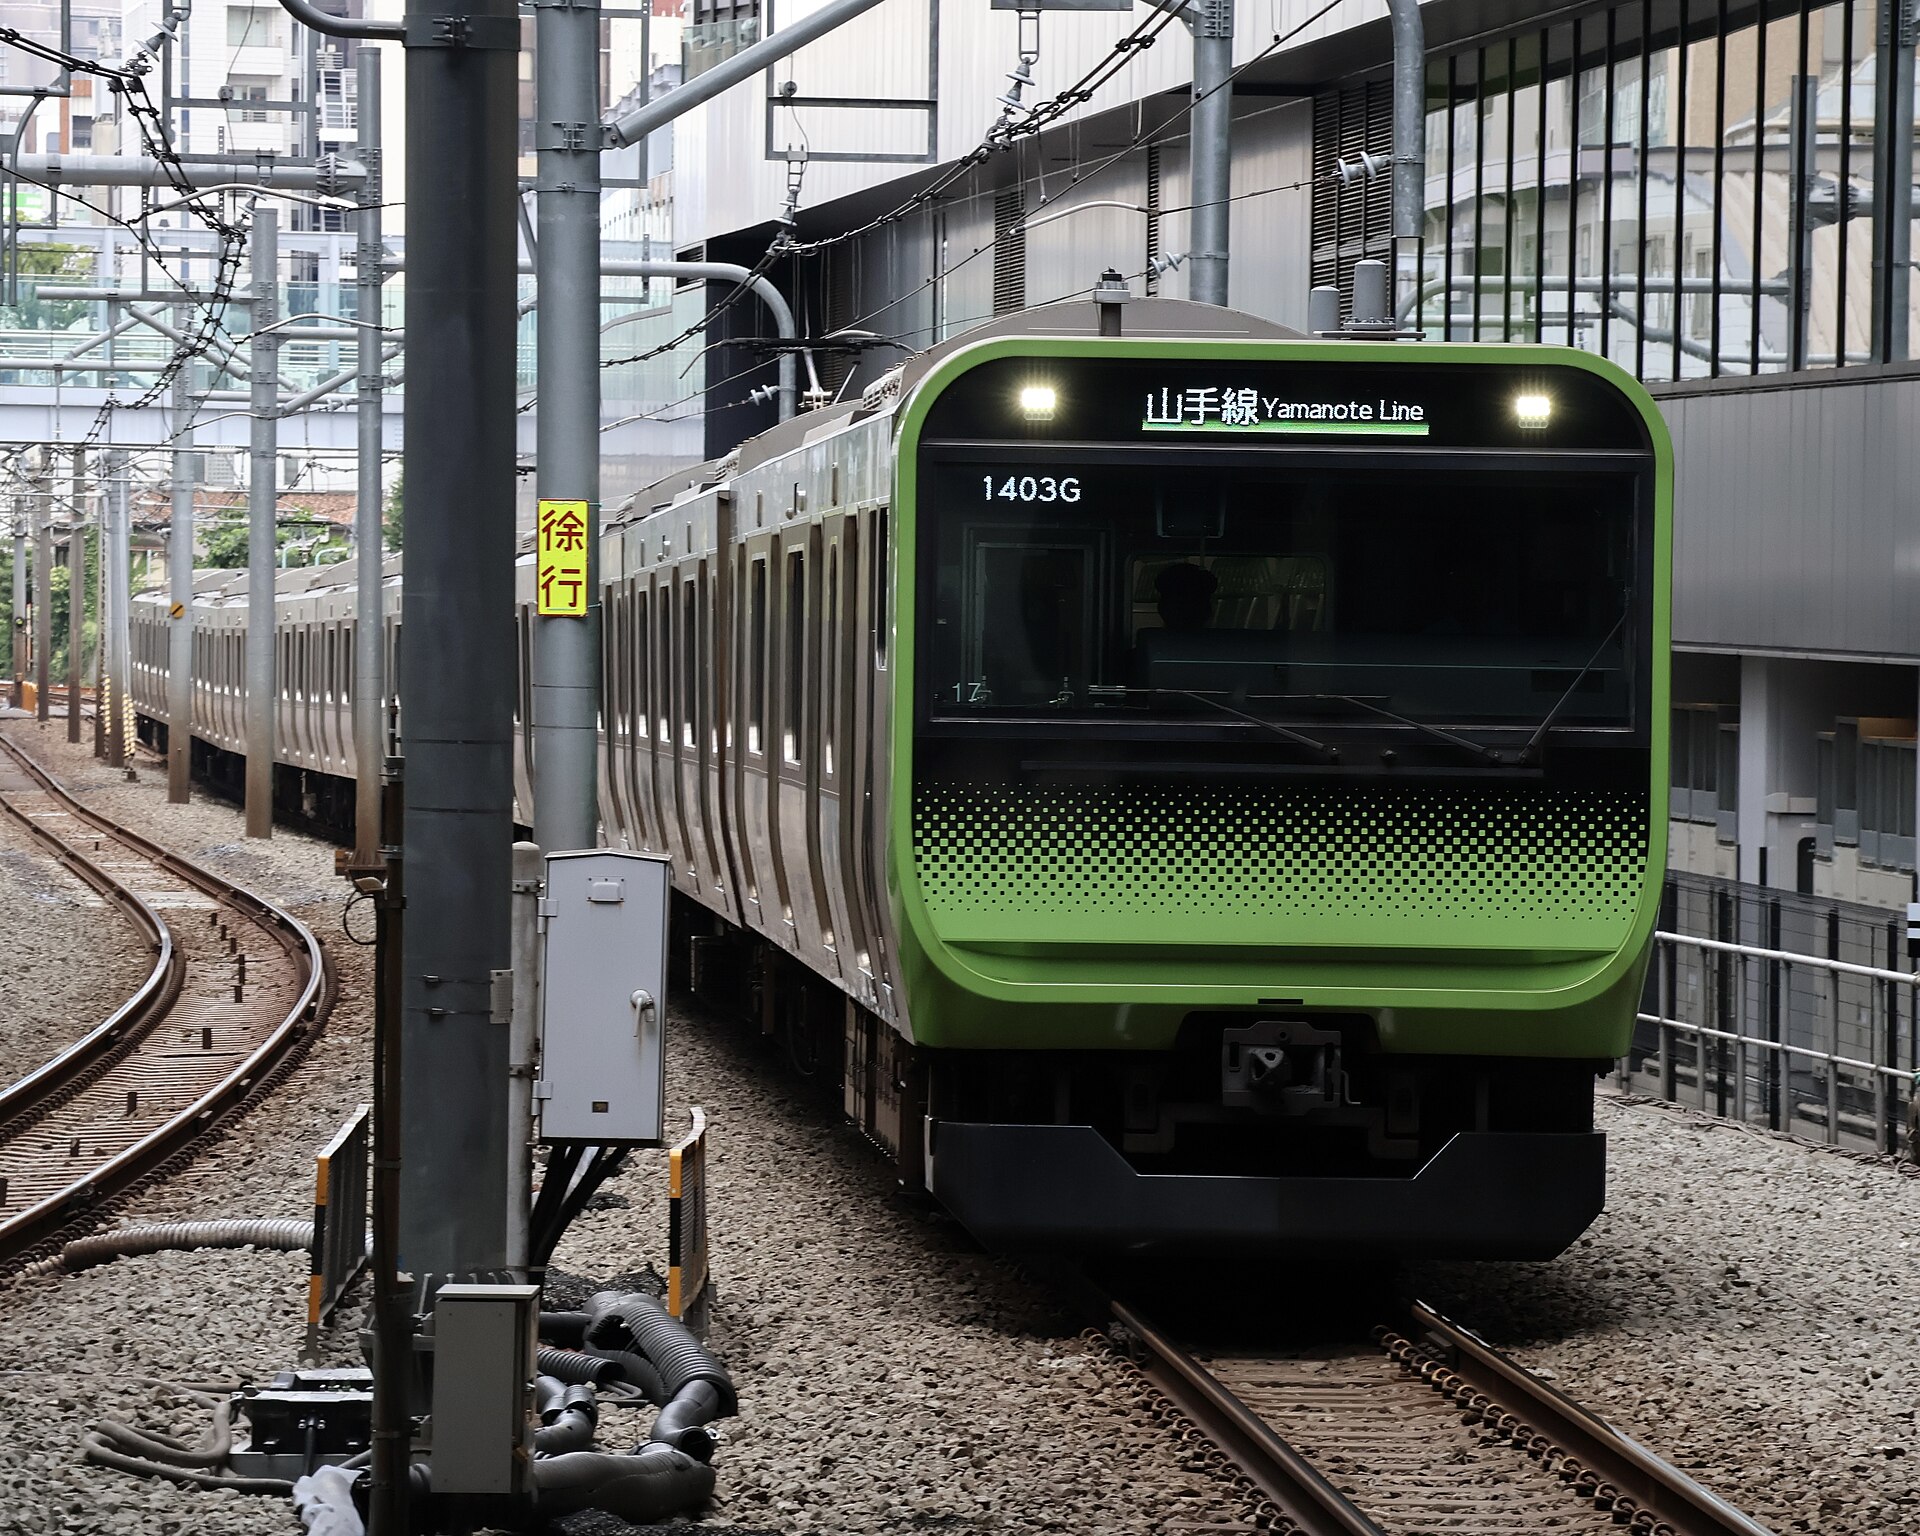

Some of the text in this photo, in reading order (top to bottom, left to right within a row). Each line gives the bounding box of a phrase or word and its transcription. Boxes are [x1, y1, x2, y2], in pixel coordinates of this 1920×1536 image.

[1146, 387, 1424, 425] 山手線 Yamanote Line
[983, 475, 1081, 502] 1403G
[541, 509, 584, 608] 徐行
[952, 682, 982, 703] 17
